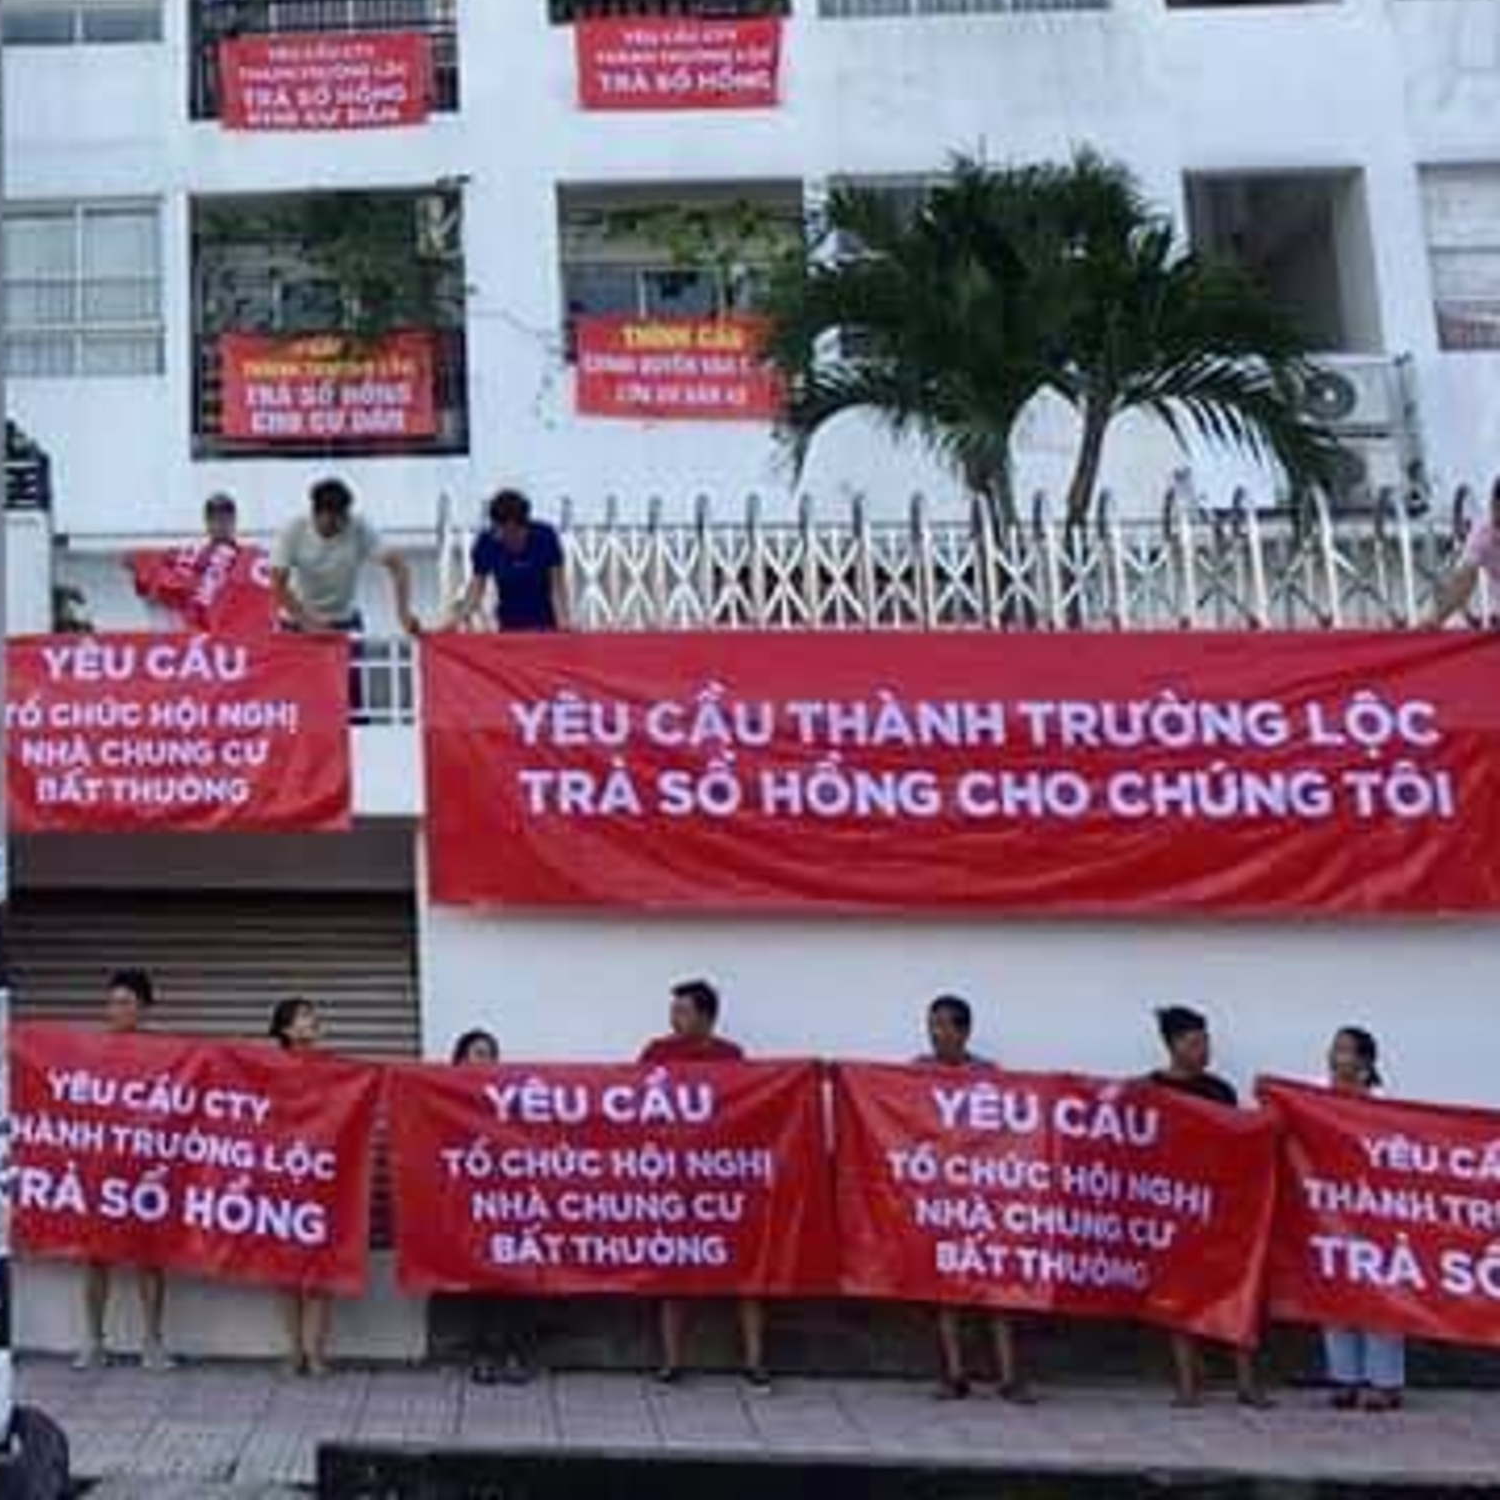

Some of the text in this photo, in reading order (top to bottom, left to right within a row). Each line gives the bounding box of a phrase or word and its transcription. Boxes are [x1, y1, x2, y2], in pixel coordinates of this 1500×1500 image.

[43, 632, 247, 681] YÊU CẦU
[510, 680, 1441, 759] YÊU CẦU THÀNH TRƯỜNG LỘC
[518, 749, 1454, 818] TRẢ SỔ HỒNG CHO CHÚNG TÔI
[48, 1067, 271, 1126] YÊU CẦU CTY
[484, 1066, 714, 1124] YÊU CẦU
[933, 1081, 1159, 1147] YÊU CẦU
[8, 1111, 104, 1153] HÀNH
[1361, 1132, 1441, 1174] YÊU
[100, 1162, 171, 1222] SỔ
[183, 1174, 328, 1246] HỒNG
[471, 1184, 746, 1223] NHÀ CHUNG CƯ
[1309, 1232, 1428, 1290] TRẢ
